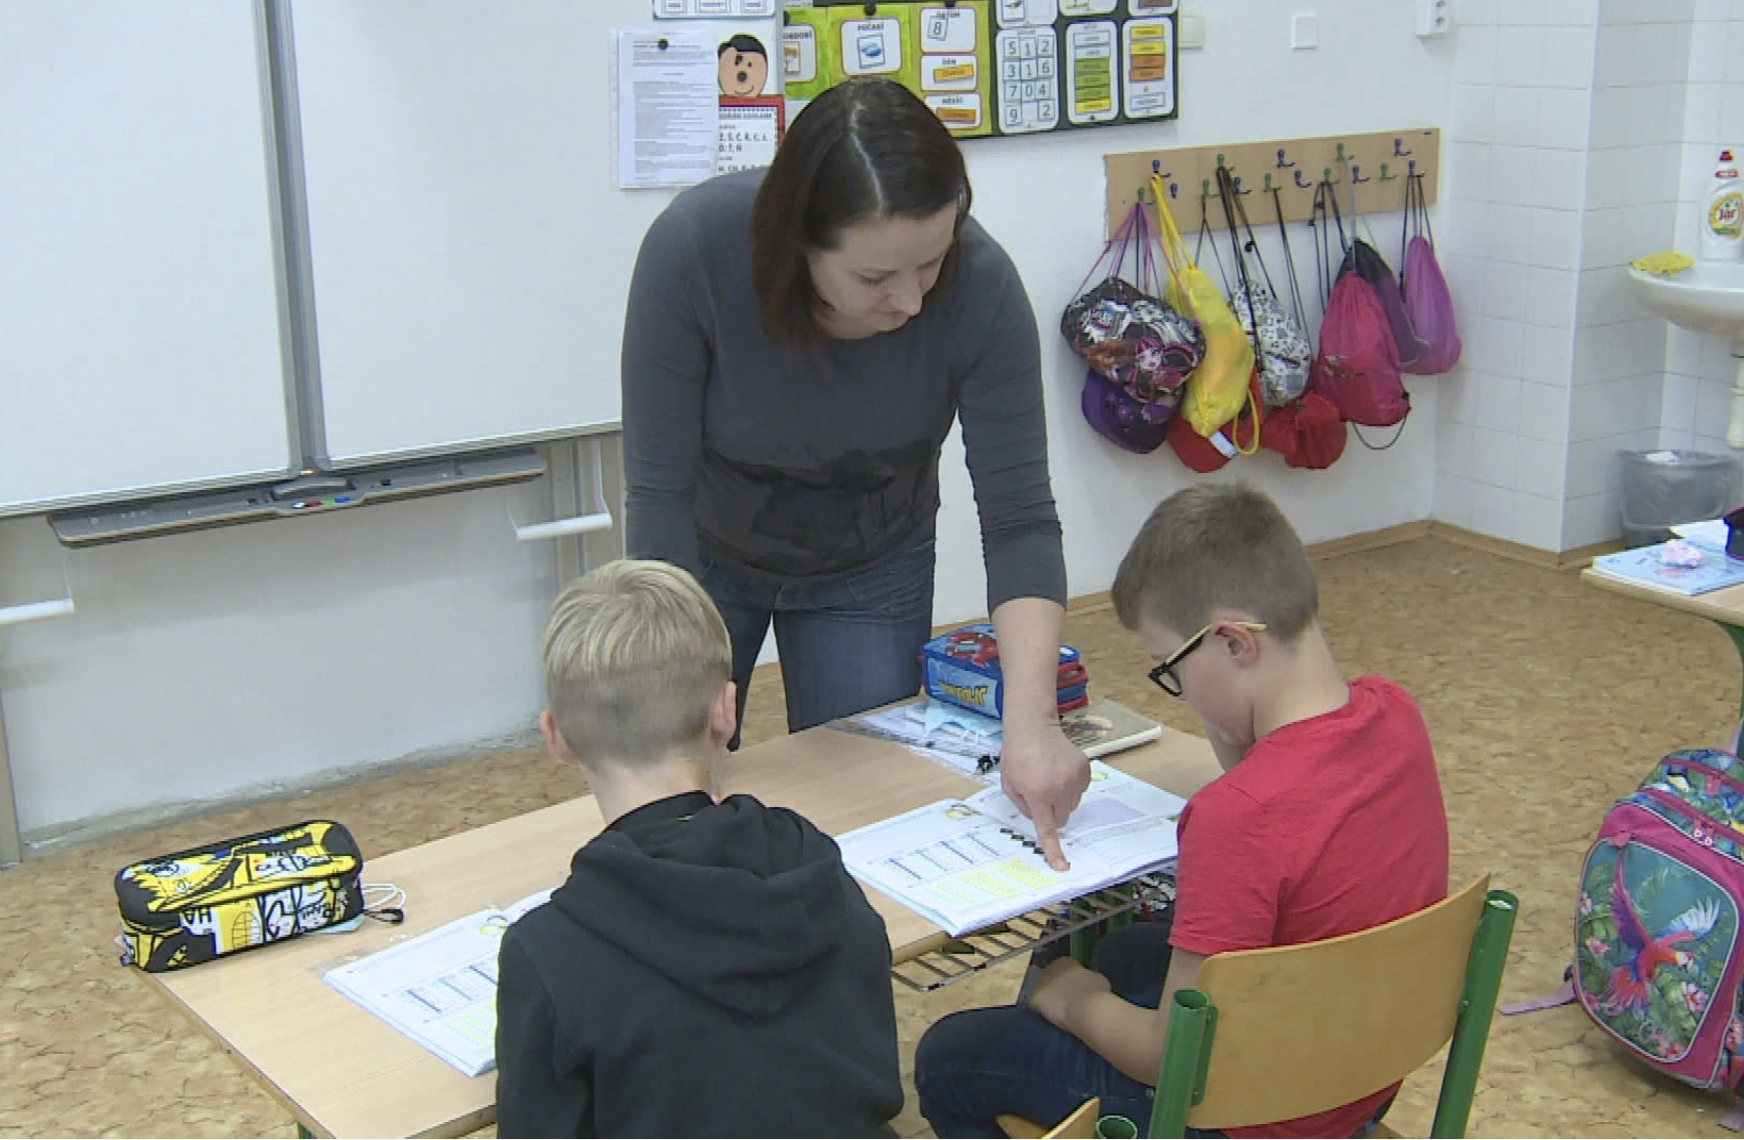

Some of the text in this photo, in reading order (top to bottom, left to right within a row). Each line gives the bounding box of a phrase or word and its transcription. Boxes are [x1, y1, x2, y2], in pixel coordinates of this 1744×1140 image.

[933, 21, 942, 35] 8
[1008, 41, 1050, 56] 5 1 2
[1008, 62, 1050, 77] 3 1 6
[1009, 83, 1046, 97] 7 0 4
[1009, 104, 1051, 122] 9 2
